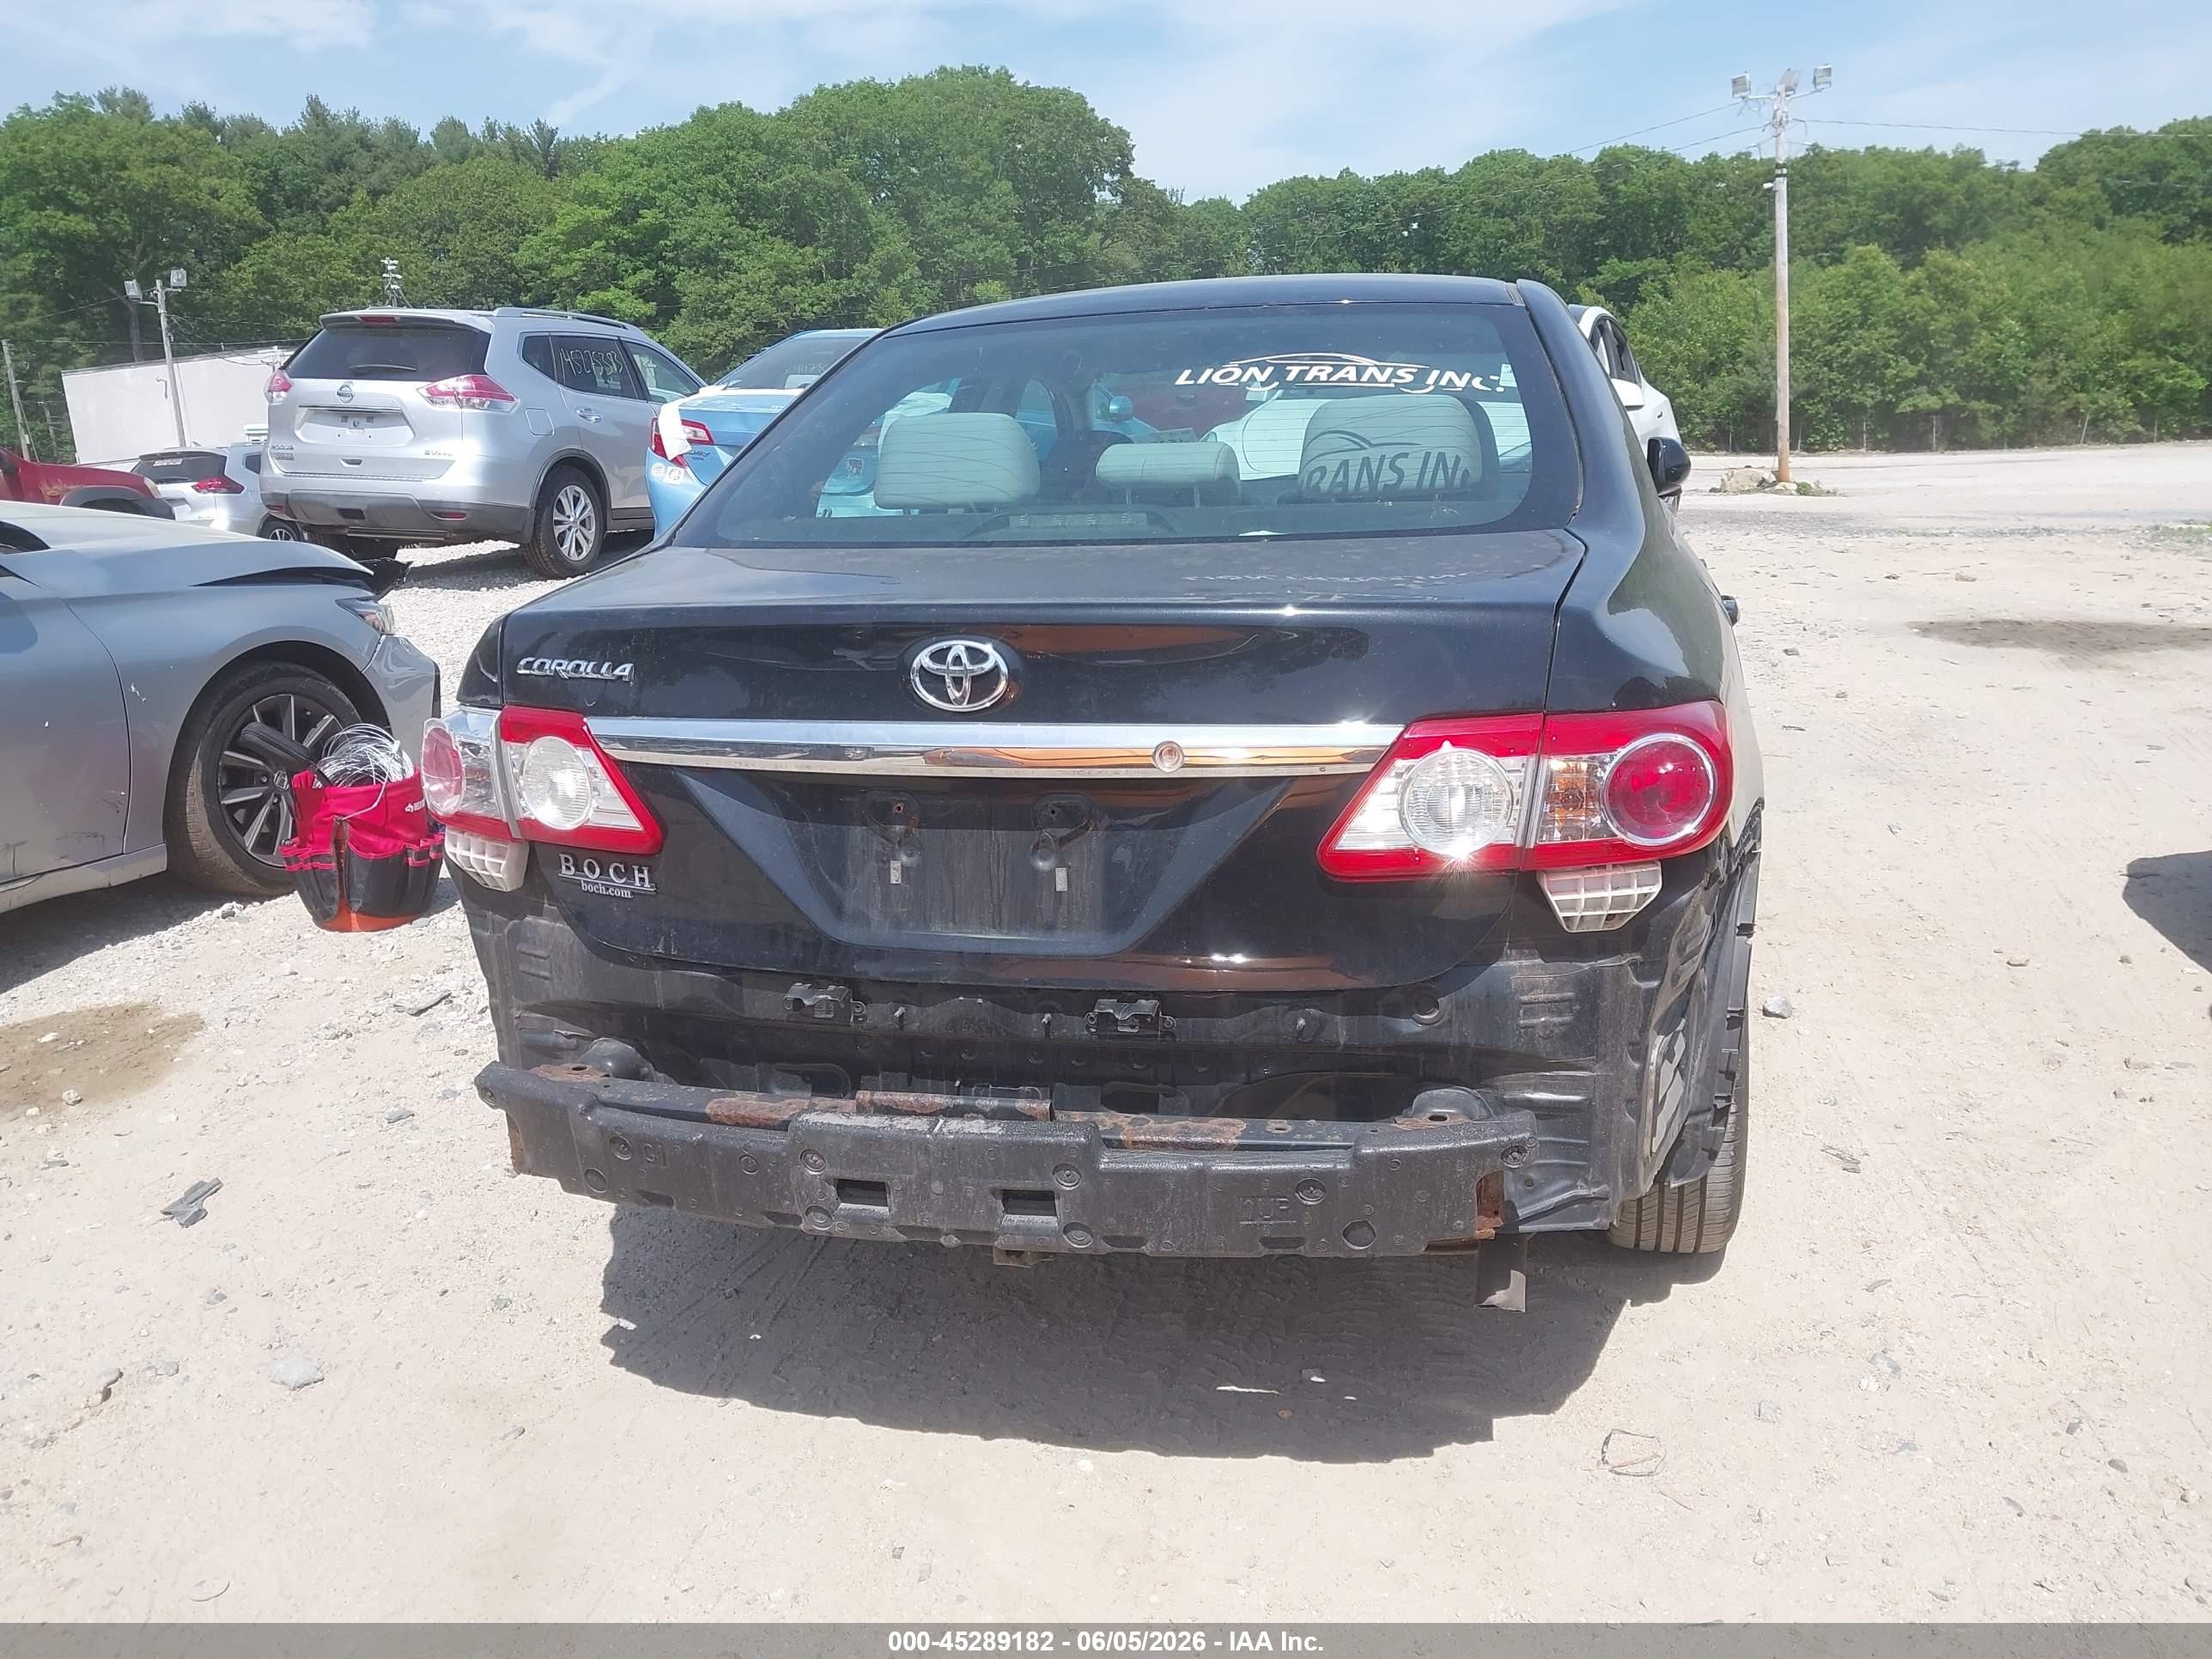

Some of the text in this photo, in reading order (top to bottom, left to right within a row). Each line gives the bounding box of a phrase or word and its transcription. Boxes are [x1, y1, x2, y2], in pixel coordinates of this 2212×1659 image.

[1175, 367, 1275, 386] LION
[1285, 365, 1418, 385] TRANS
[516, 656, 635, 683] COROLLA
[559, 853, 651, 888] BOCH
[580, 880, 634, 899] boch.com
